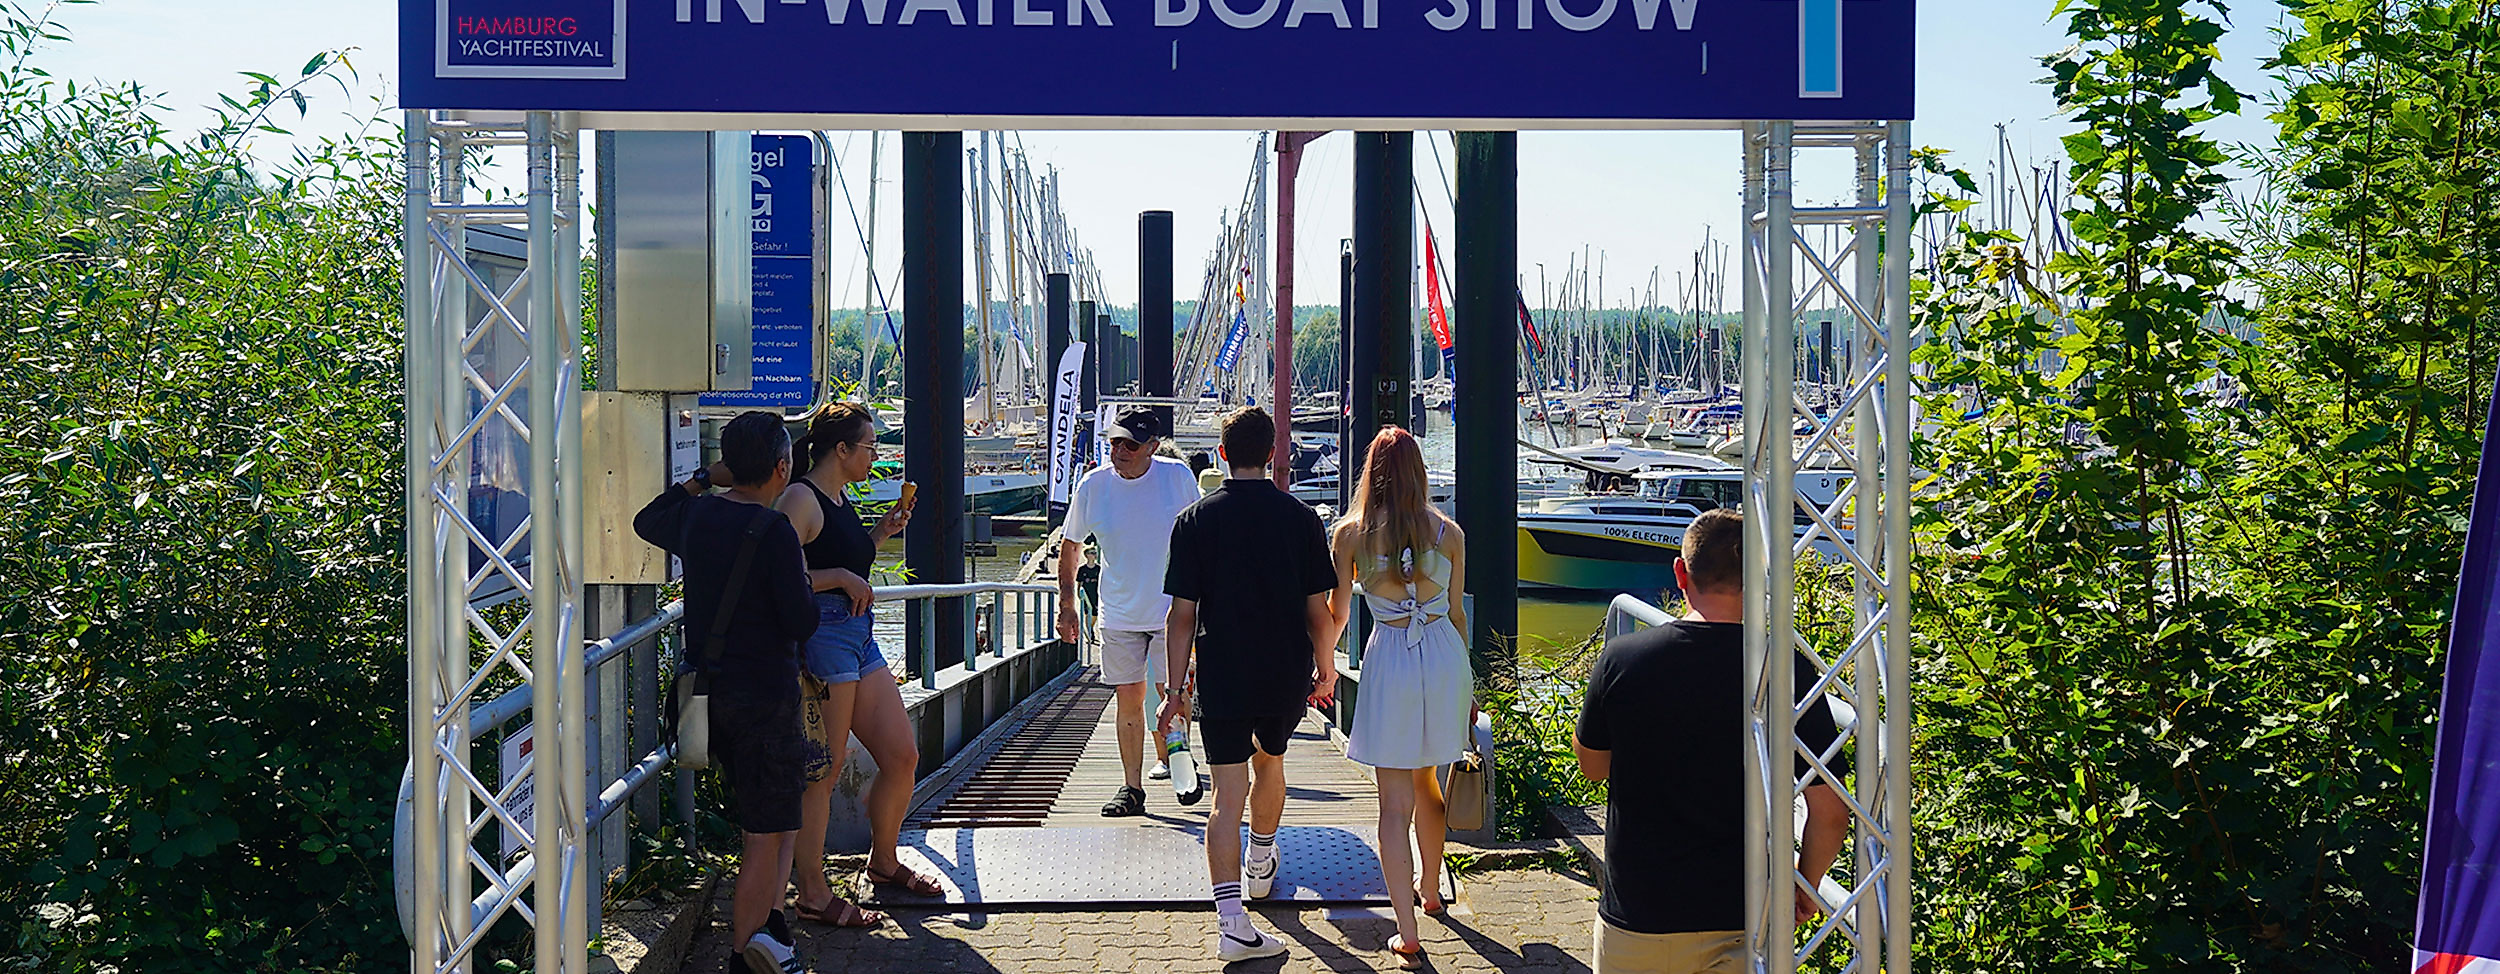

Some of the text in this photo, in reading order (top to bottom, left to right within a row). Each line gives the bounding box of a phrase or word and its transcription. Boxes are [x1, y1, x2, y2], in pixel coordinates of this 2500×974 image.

[458, 16, 577, 36] HAMBURG
[458, 39, 604, 57] YACHTFESTIVAL
[766, 355, 783, 363] eine
[765, 374, 802, 382] Nachbarn
[783, 391, 802, 400] HYG
[1055, 369, 1075, 485] CANDELA
[1604, 526, 1680, 545] 100% ELECTRIC
